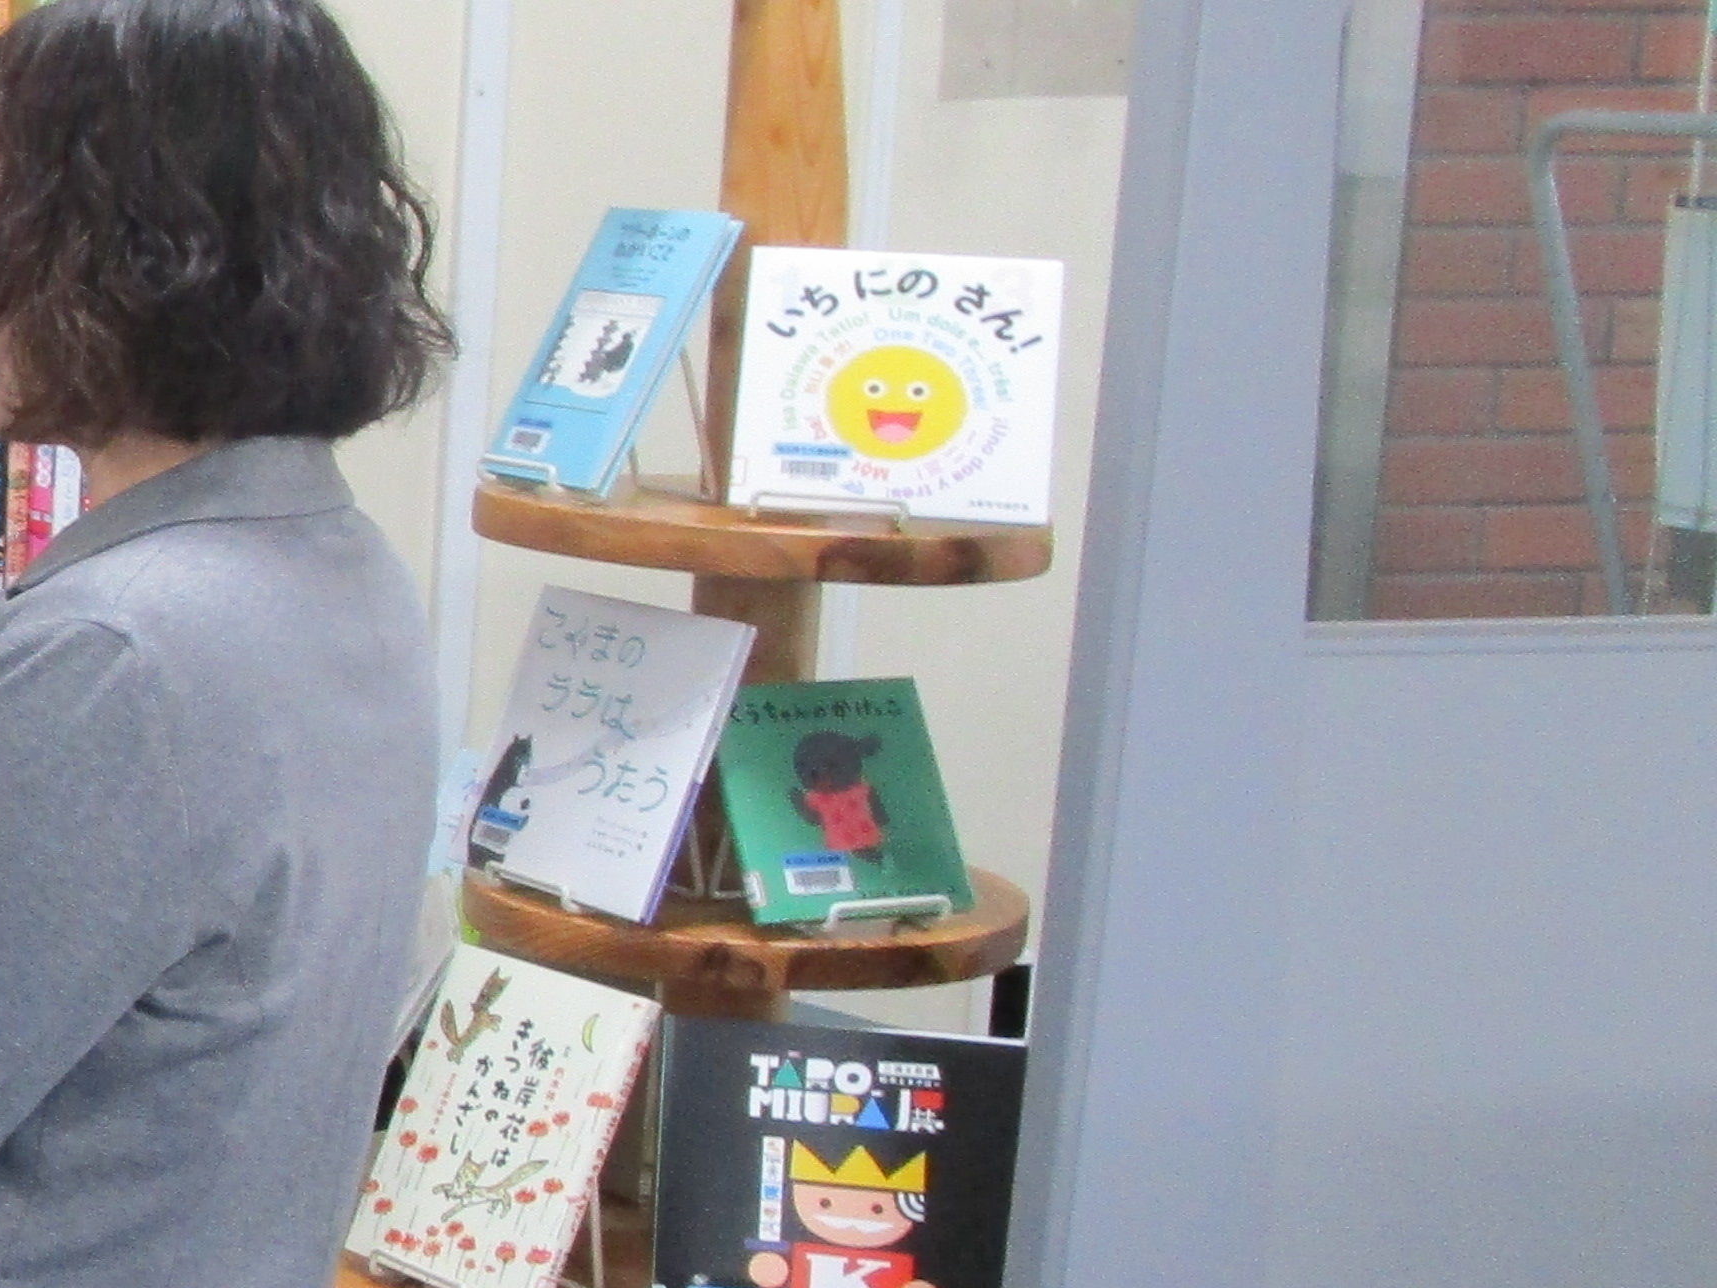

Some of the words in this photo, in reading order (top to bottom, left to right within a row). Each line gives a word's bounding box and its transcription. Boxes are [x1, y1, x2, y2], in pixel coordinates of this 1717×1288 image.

[765, 283, 840, 341] いち
[853, 267, 939, 301] にの
[953, 282, 1043, 355] さん!
[872, 327, 914, 343] One
[921, 333, 958, 359] Two
[888, 307, 921, 324] Um
[577, 746, 669, 813] うたう
[484, 1017, 536, 1124] きつねの
[490, 1036, 556, 1169] 彼岸花は
[748, 1049, 873, 1096] TARO
[449, 1055, 496, 1155] かんざし
[747, 1086, 891, 1132] MIURA
